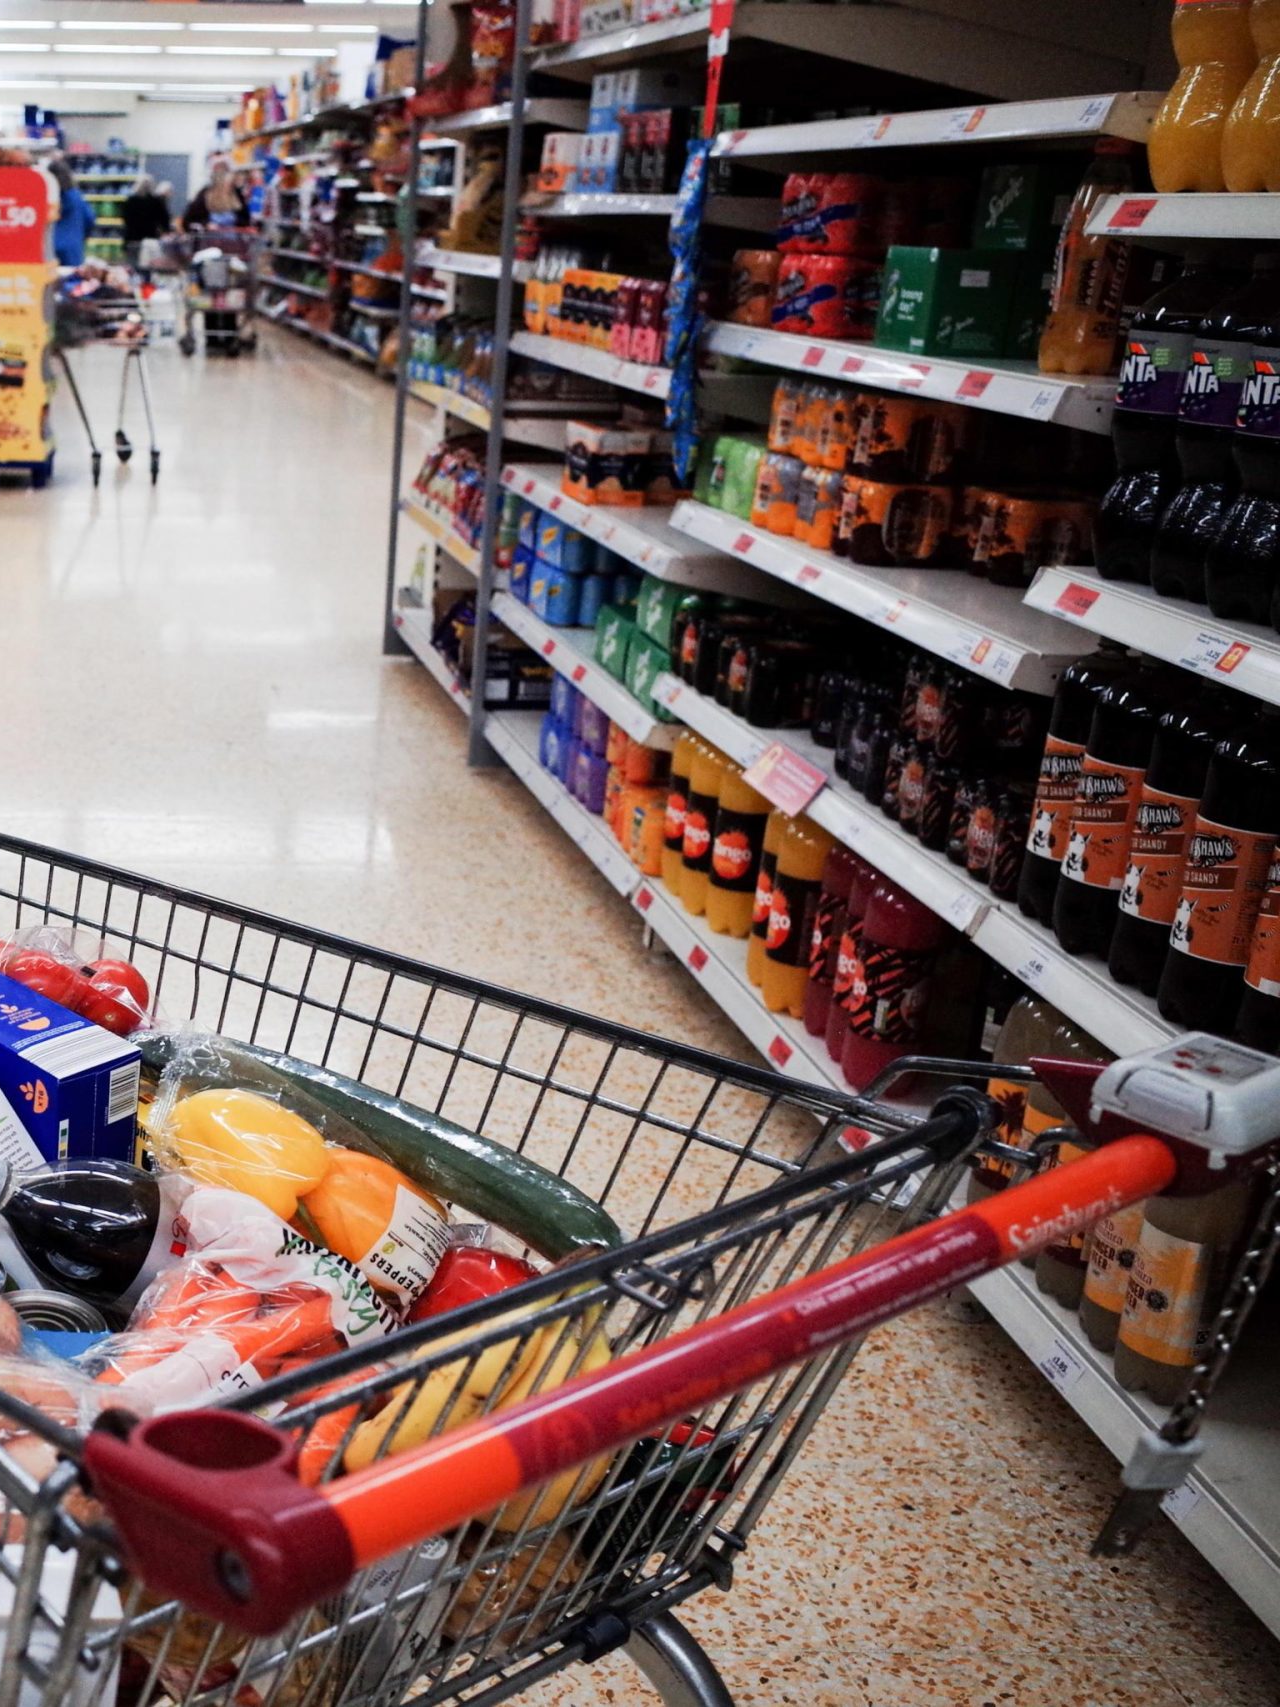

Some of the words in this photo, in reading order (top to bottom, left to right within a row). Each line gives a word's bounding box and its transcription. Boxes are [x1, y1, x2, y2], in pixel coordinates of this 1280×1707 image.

[1121, 354, 1157, 383] NTA
[1183, 365, 1219, 394] NTA
[313, 1254, 380, 1336] tasty
[369, 1252, 421, 1300] PEPPERS
